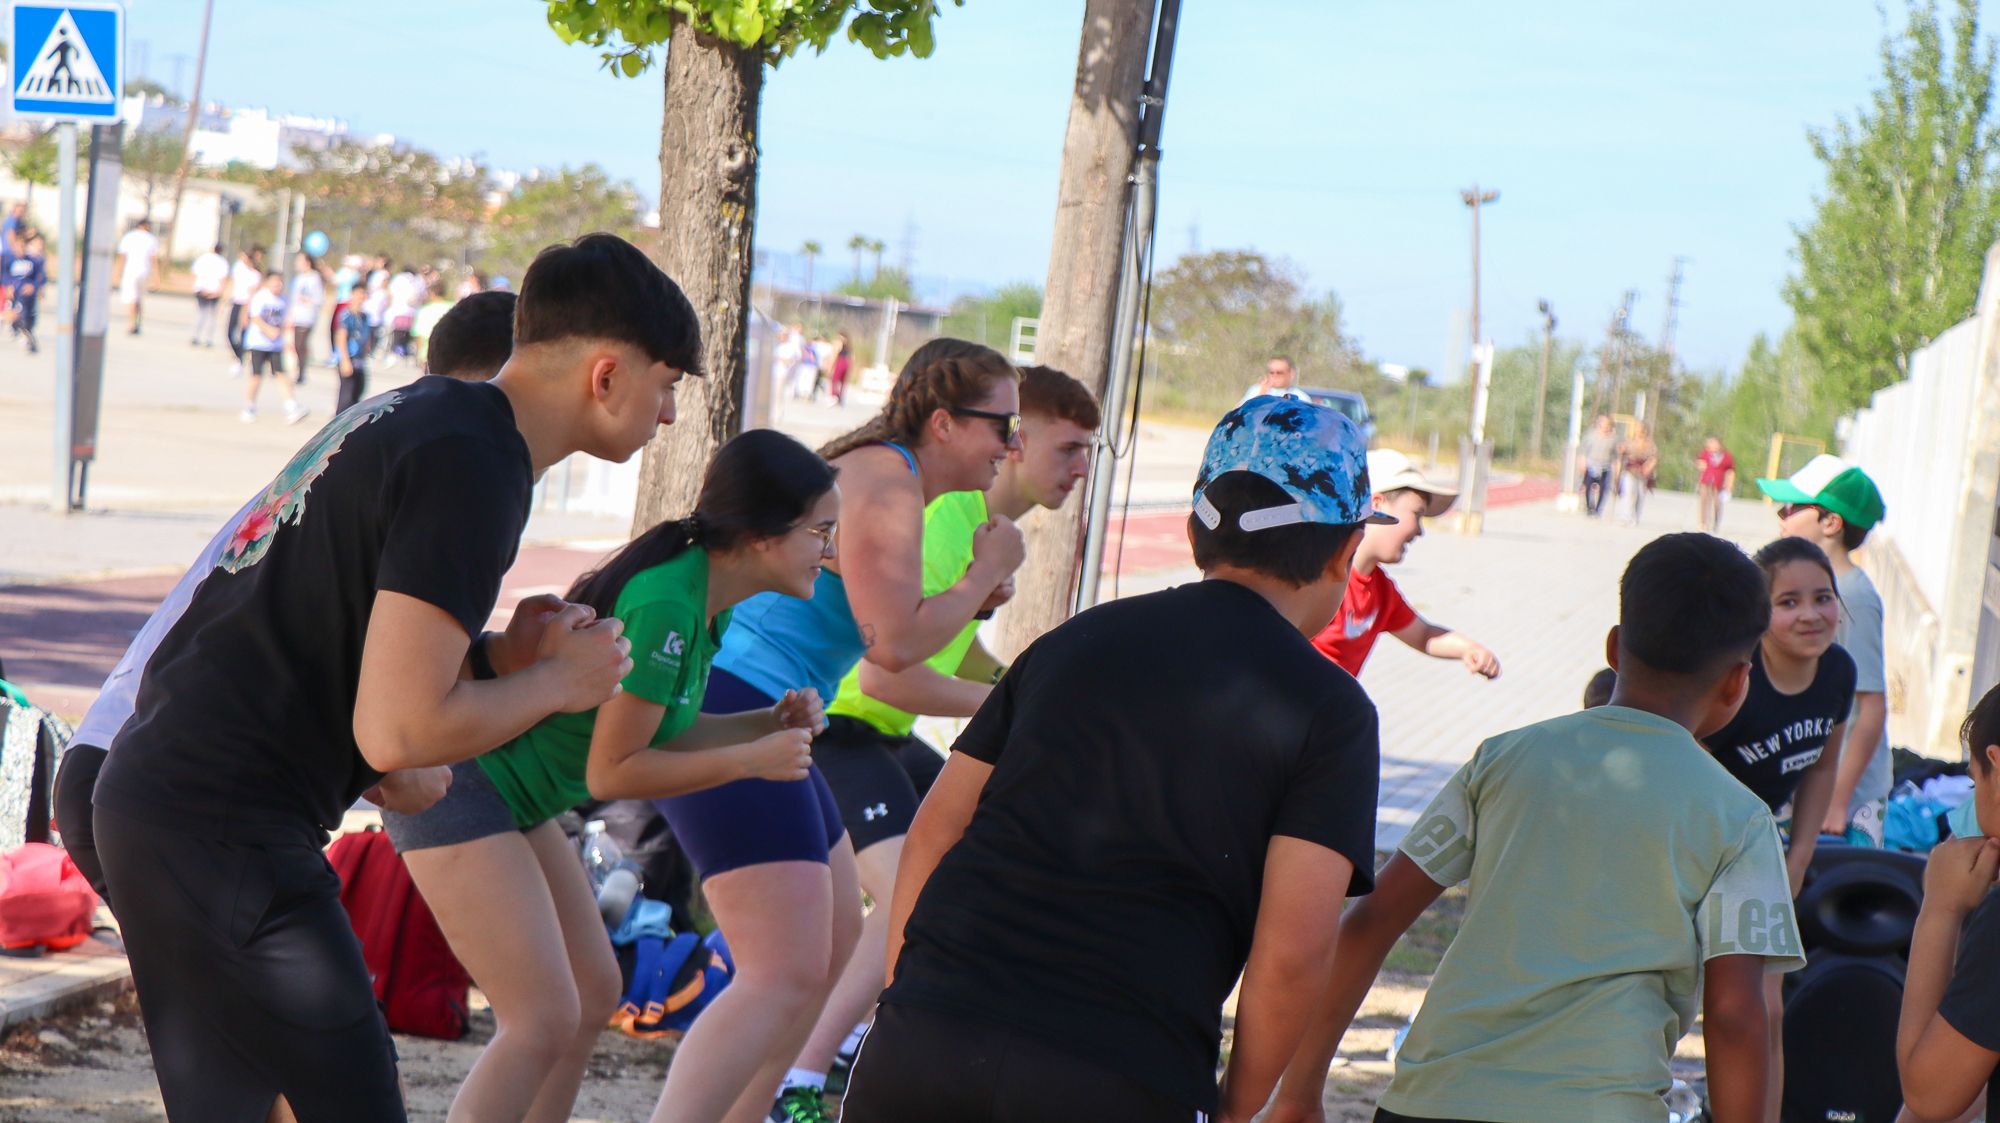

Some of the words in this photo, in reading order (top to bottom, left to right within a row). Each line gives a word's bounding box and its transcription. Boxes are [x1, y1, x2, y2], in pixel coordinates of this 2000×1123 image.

[1736, 733, 1781, 765] NEW
[1784, 717, 1824, 744] YORK
[1708, 892, 1797, 955] Lea
